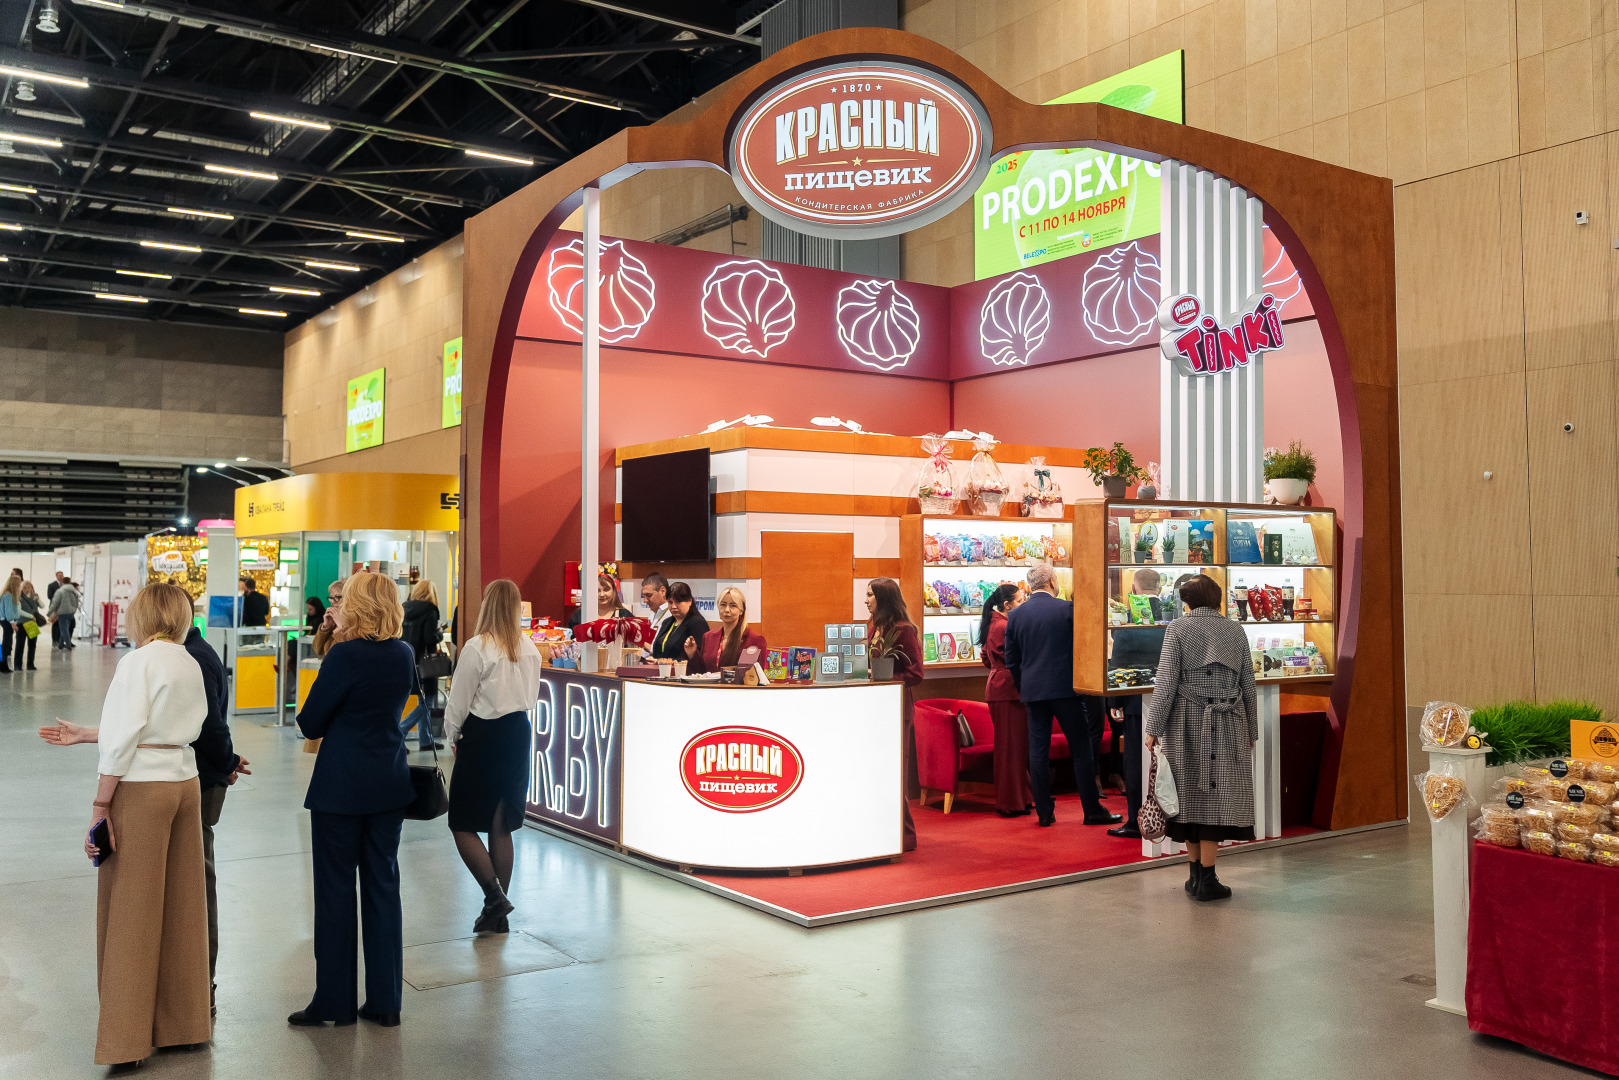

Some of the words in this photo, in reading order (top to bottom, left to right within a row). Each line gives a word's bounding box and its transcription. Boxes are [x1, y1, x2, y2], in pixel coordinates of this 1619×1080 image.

[842, 83, 871, 93] 1870
[775, 97, 940, 166] КРАСНЫЙ
[996, 158, 1018, 174] 2025
[795, 195, 873, 211] КОНДИТЕРСКАЯ
[878, 189, 925, 208] ФАБРИКА
[1028, 222, 1040, 236] 11
[1043, 216, 1060, 231] ПО
[1062, 211, 1076, 226] 14
[1078, 195, 1126, 221] НОЯБРЯ
[347, 399, 383, 427] PRODEXPO
[526, 678, 618, 828] R.BY
[695, 742, 783, 778] КРАСНЫЙ
